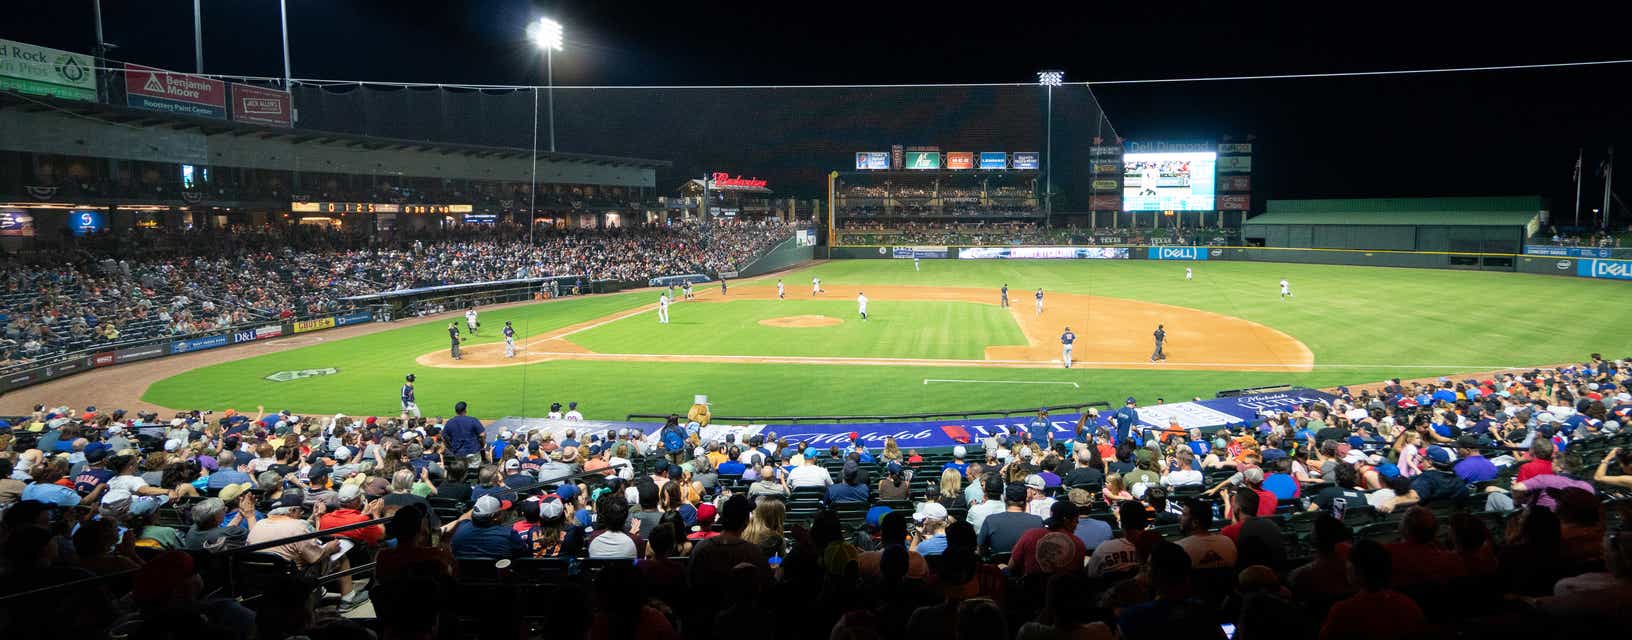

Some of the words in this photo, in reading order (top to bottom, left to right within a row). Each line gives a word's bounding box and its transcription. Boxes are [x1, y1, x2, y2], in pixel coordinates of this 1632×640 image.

[12, 46, 47, 63] Rock
[166, 75, 212, 91] Benjamin
[166, 86, 200, 98] Moore
[174, 103, 191, 112] Paint
[192, 106, 213, 115] Center
[1131, 142, 1152, 152] Dell
[1156, 142, 1208, 152] Diamond
[234, 331, 256, 343] D&L
